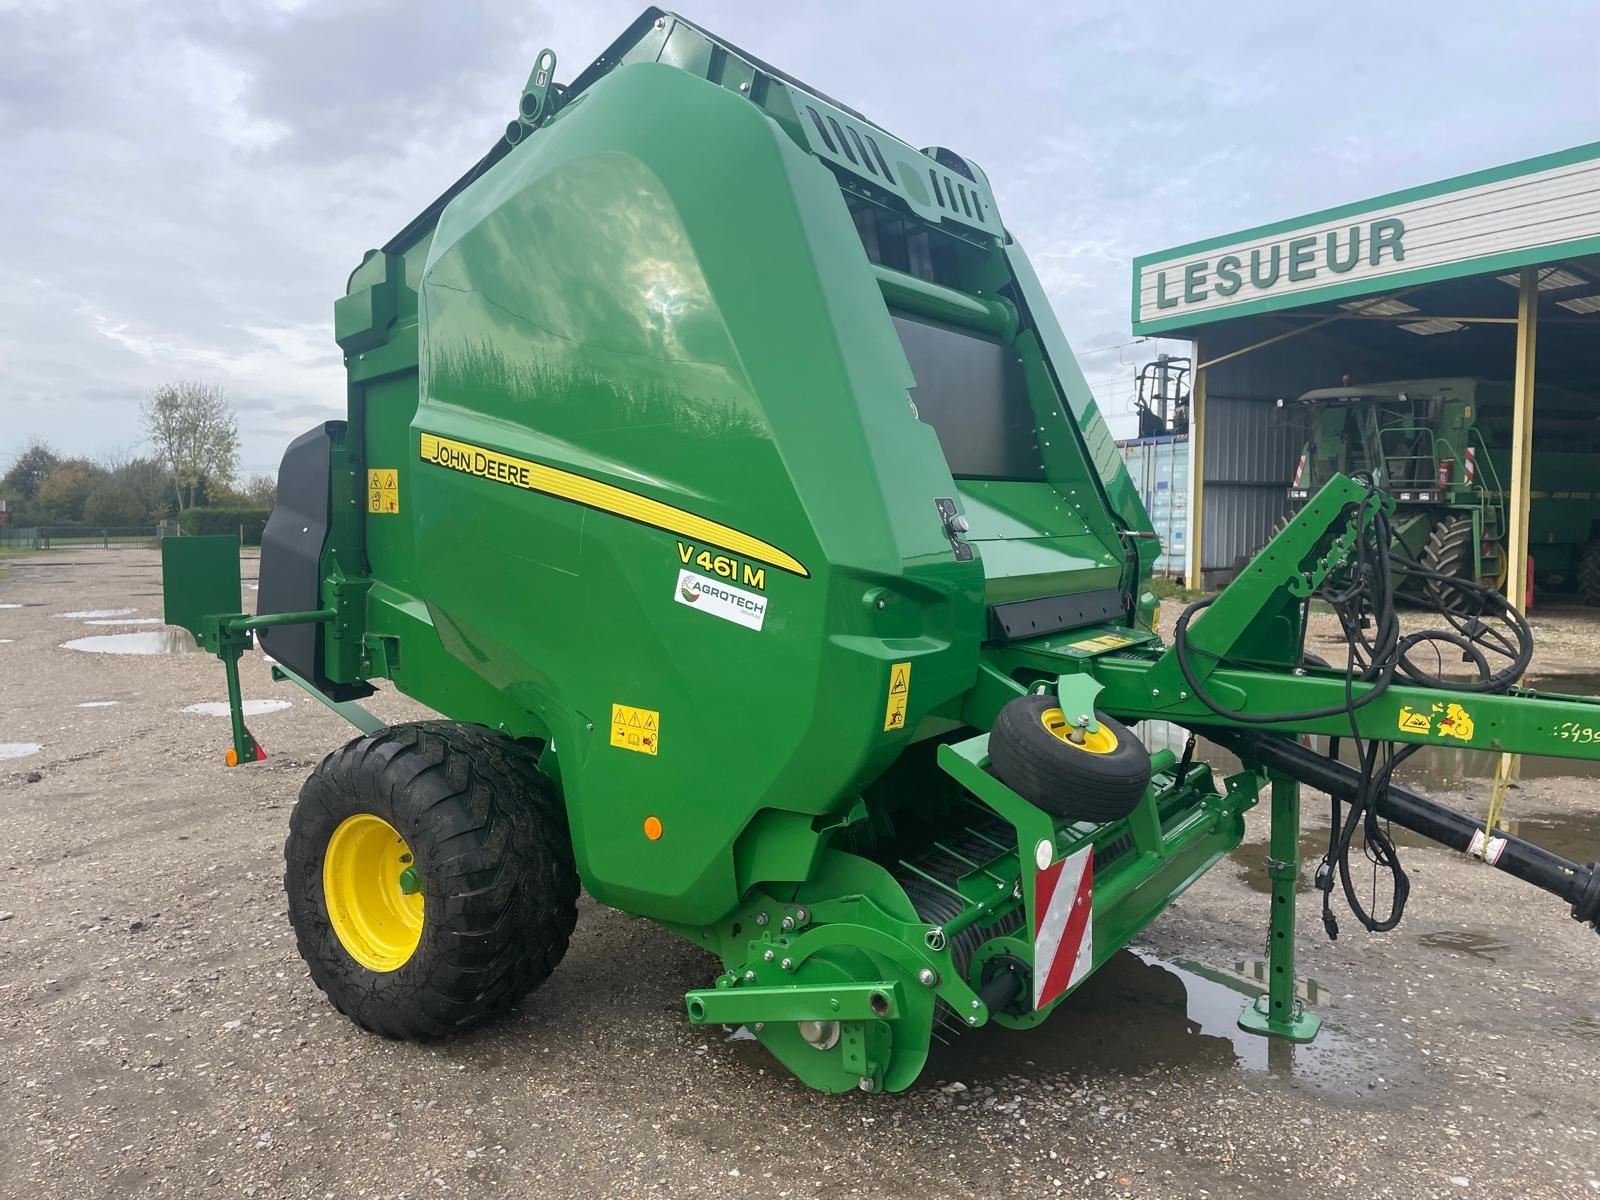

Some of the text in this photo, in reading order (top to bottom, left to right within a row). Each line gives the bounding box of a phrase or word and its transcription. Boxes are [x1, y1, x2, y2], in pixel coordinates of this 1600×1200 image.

[1157, 218, 1405, 309] LESUEUR
[432, 441, 530, 486] JOHN DEERE
[677, 541, 765, 592] V 461 M
[692, 581, 764, 615] AGROTECH
